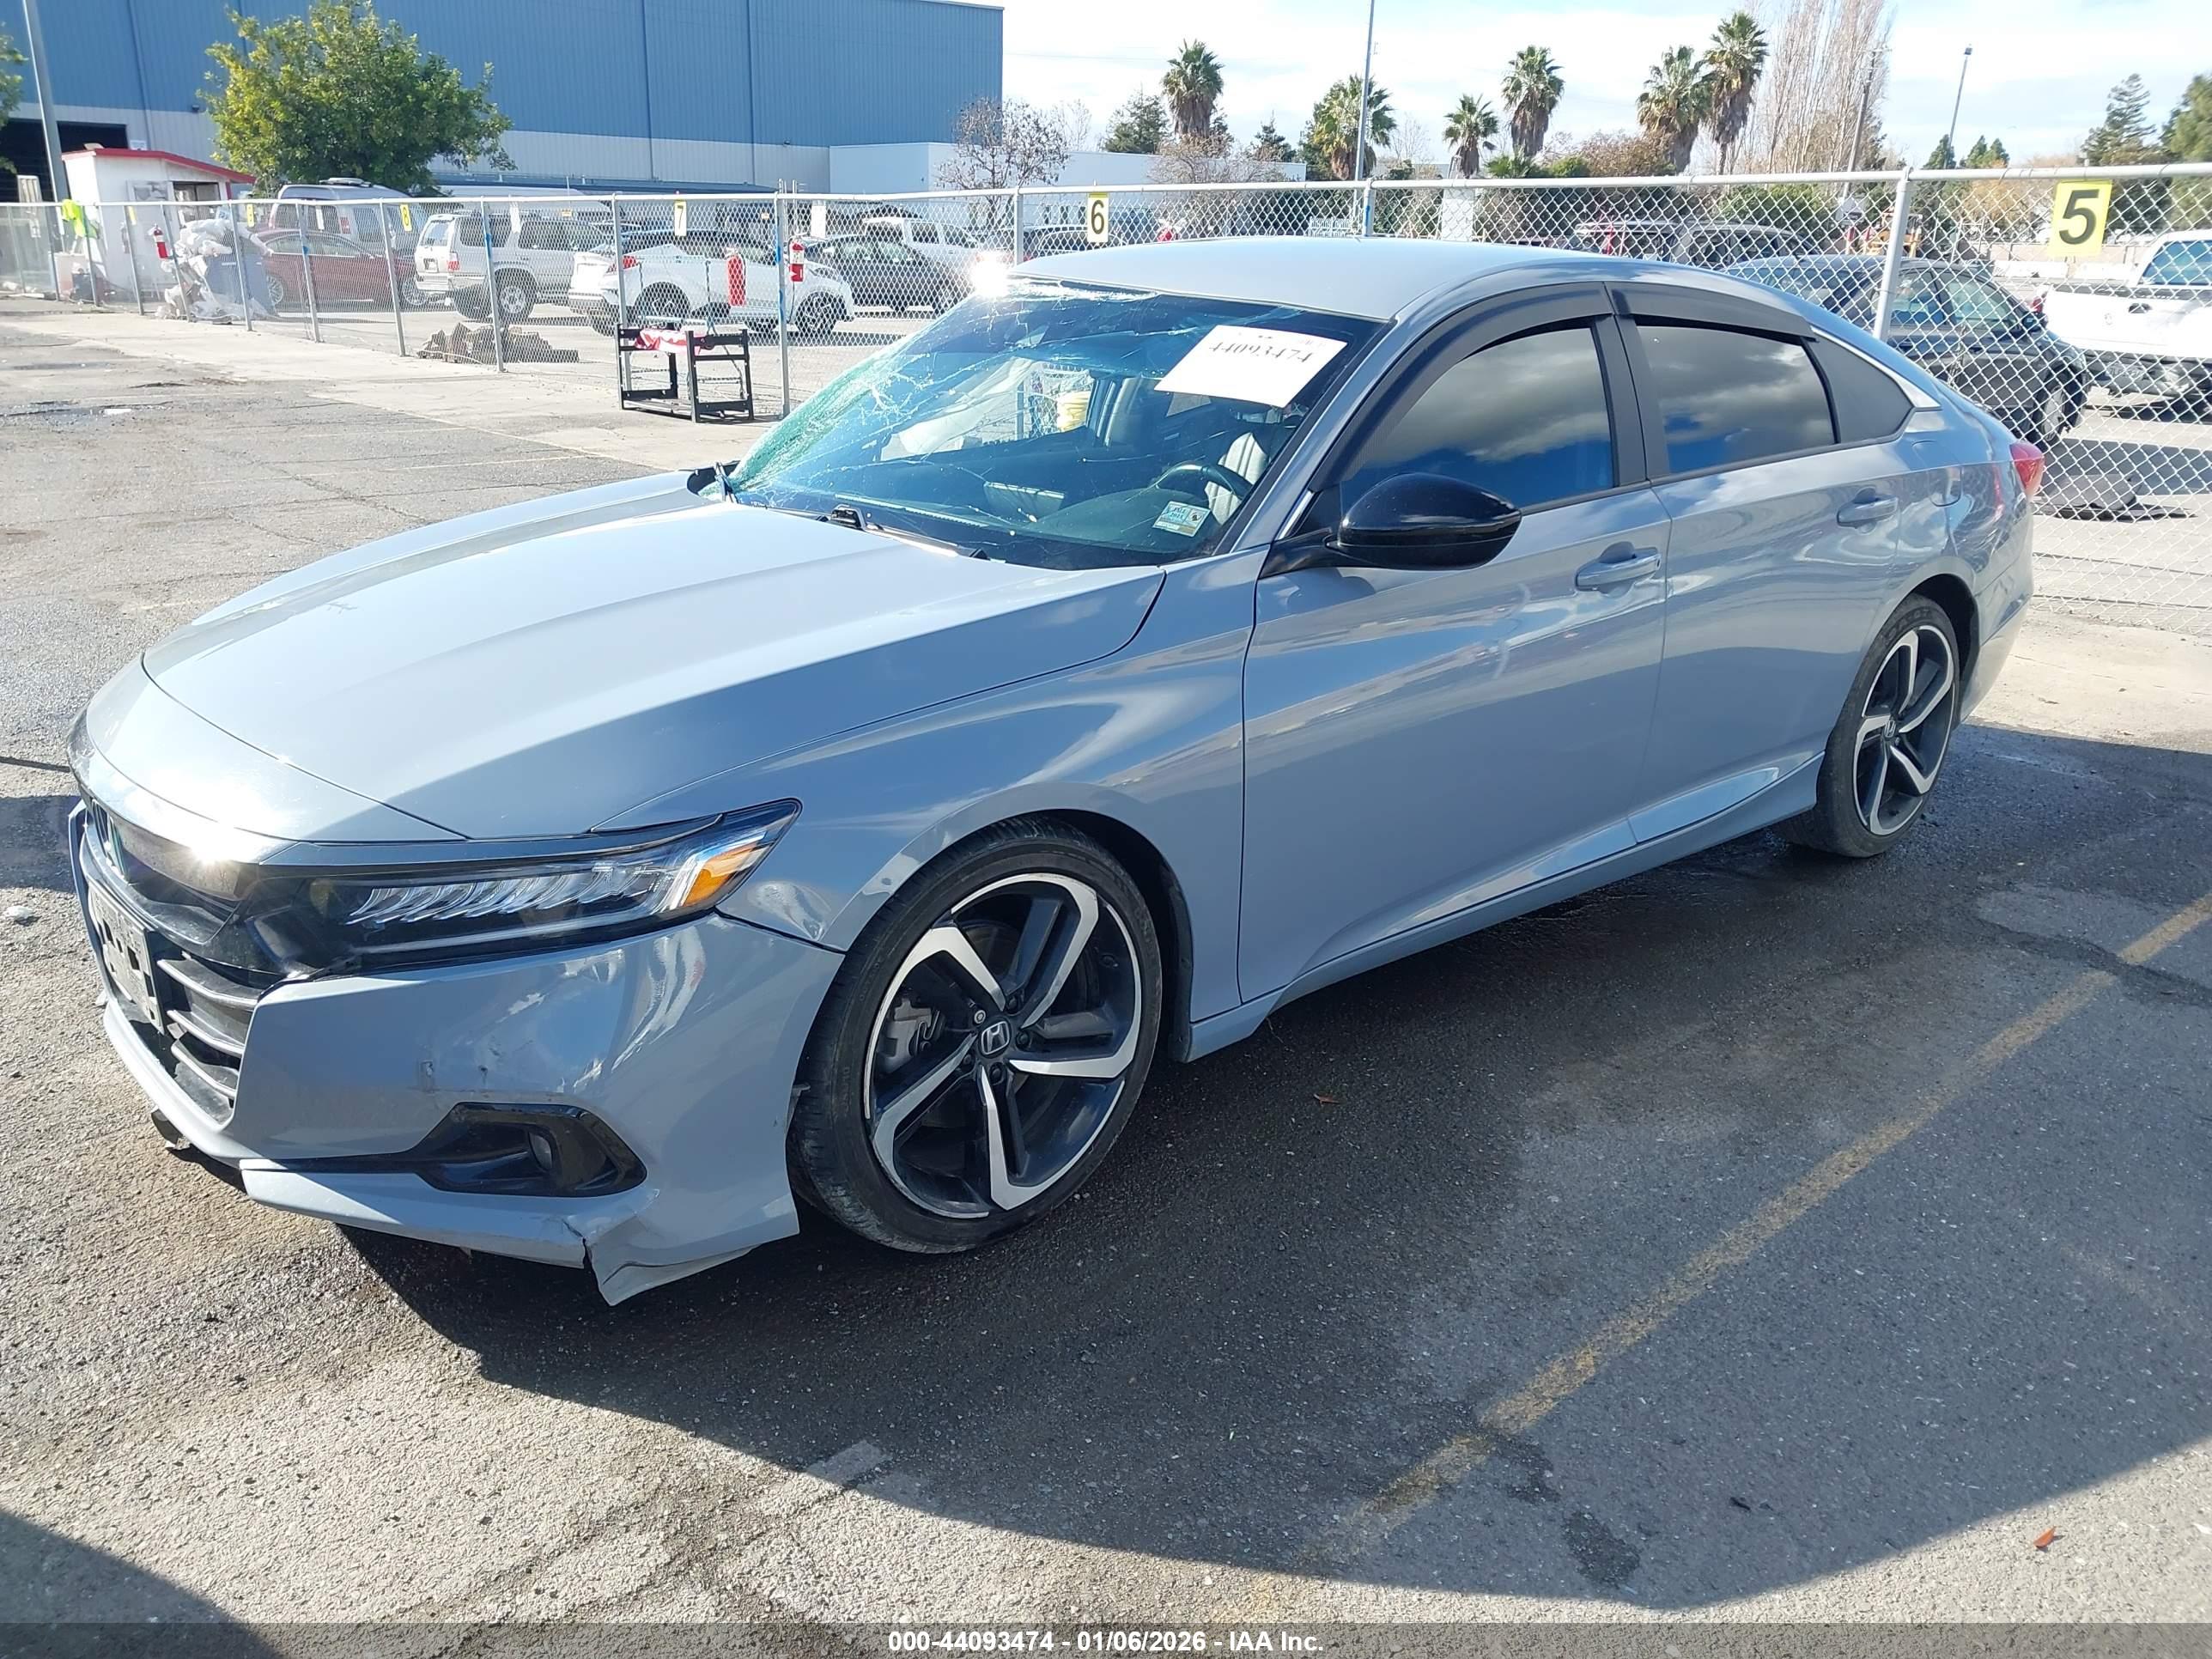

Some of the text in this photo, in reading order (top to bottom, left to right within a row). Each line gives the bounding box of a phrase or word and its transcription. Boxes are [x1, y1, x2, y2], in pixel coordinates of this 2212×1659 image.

[677, 204, 684, 230] 7
[1091, 199, 1105, 234] 6
[2058, 188, 2100, 246] 5
